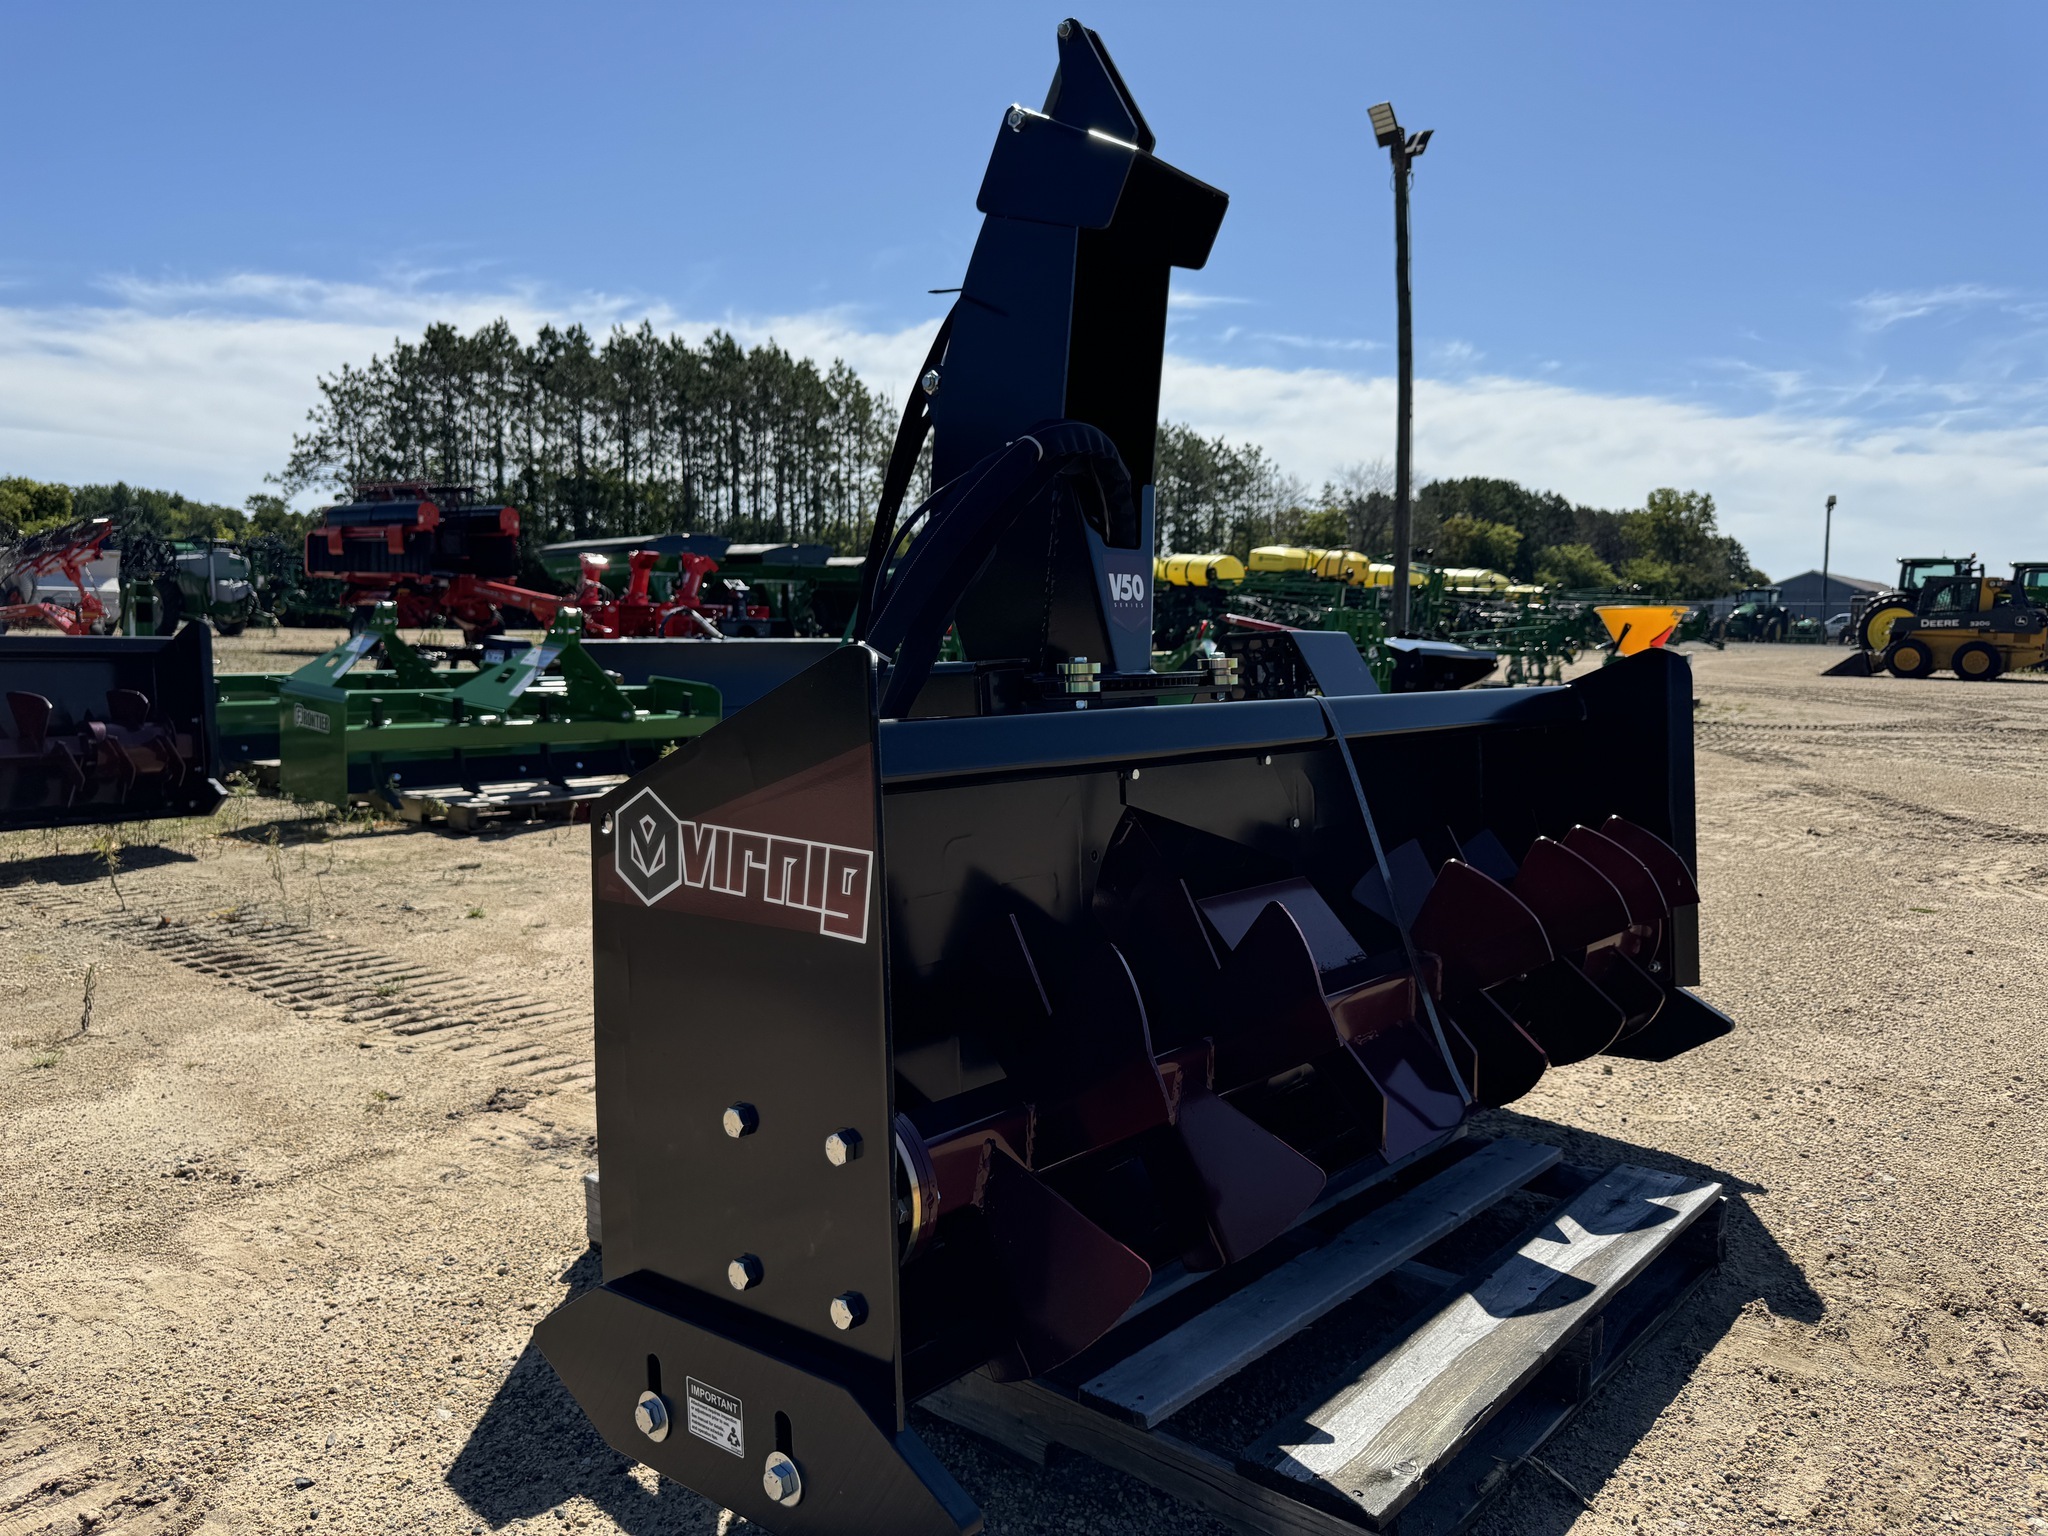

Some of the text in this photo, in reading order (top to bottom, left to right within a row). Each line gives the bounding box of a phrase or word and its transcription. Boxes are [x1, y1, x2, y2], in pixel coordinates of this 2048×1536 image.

[1108, 573, 1144, 601] V50
[1920, 619, 1960, 628] DEERE
[295, 704, 330, 731] FRONTIER
[691, 1384, 738, 1413] IMPORTANT
